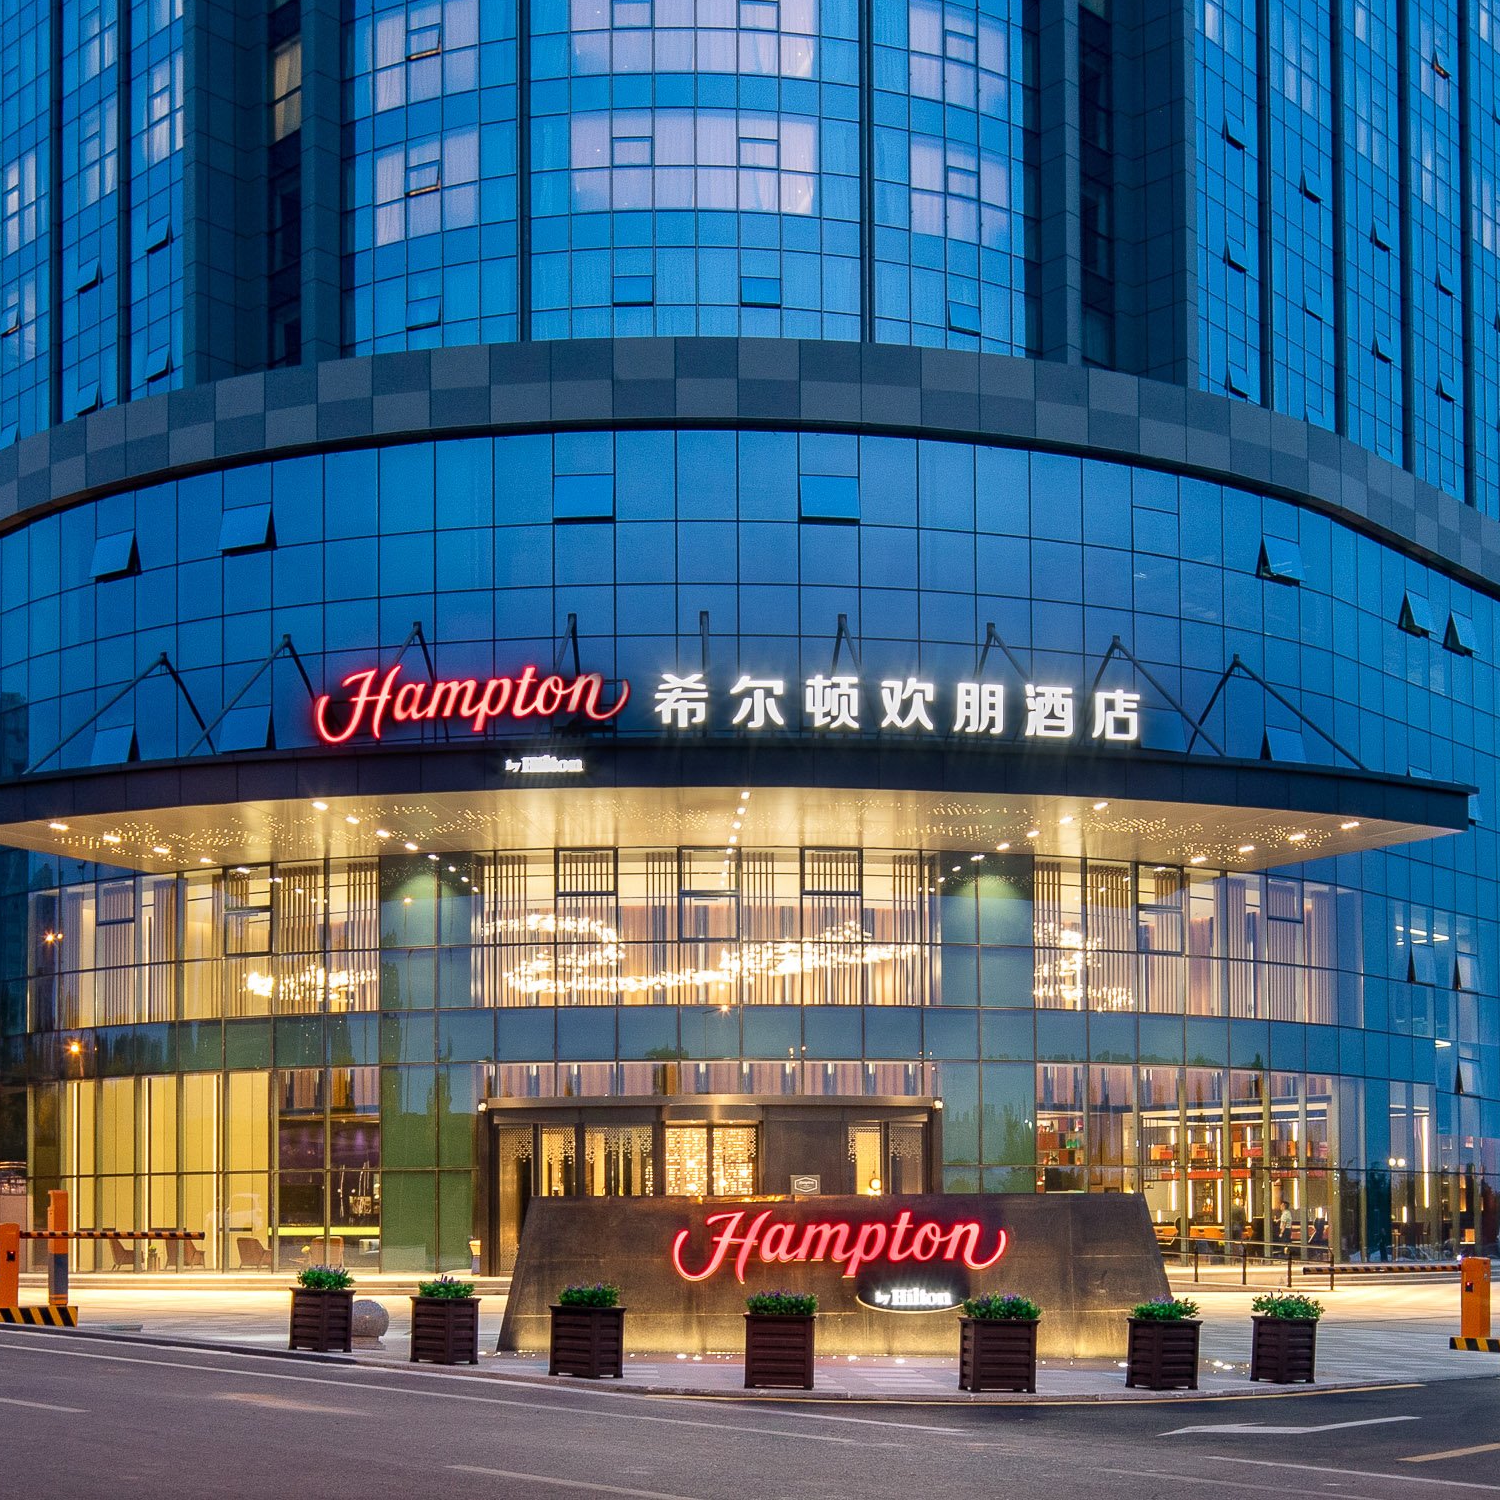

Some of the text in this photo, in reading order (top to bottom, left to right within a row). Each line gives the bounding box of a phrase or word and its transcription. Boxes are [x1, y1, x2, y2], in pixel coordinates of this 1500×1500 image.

[315, 664, 629, 743] Hampton
[654, 673, 1141, 741] 希尔顿欢朋酒店
[672, 1208, 1008, 1284] Hampton
[875, 1287, 953, 1305] by Hilton
